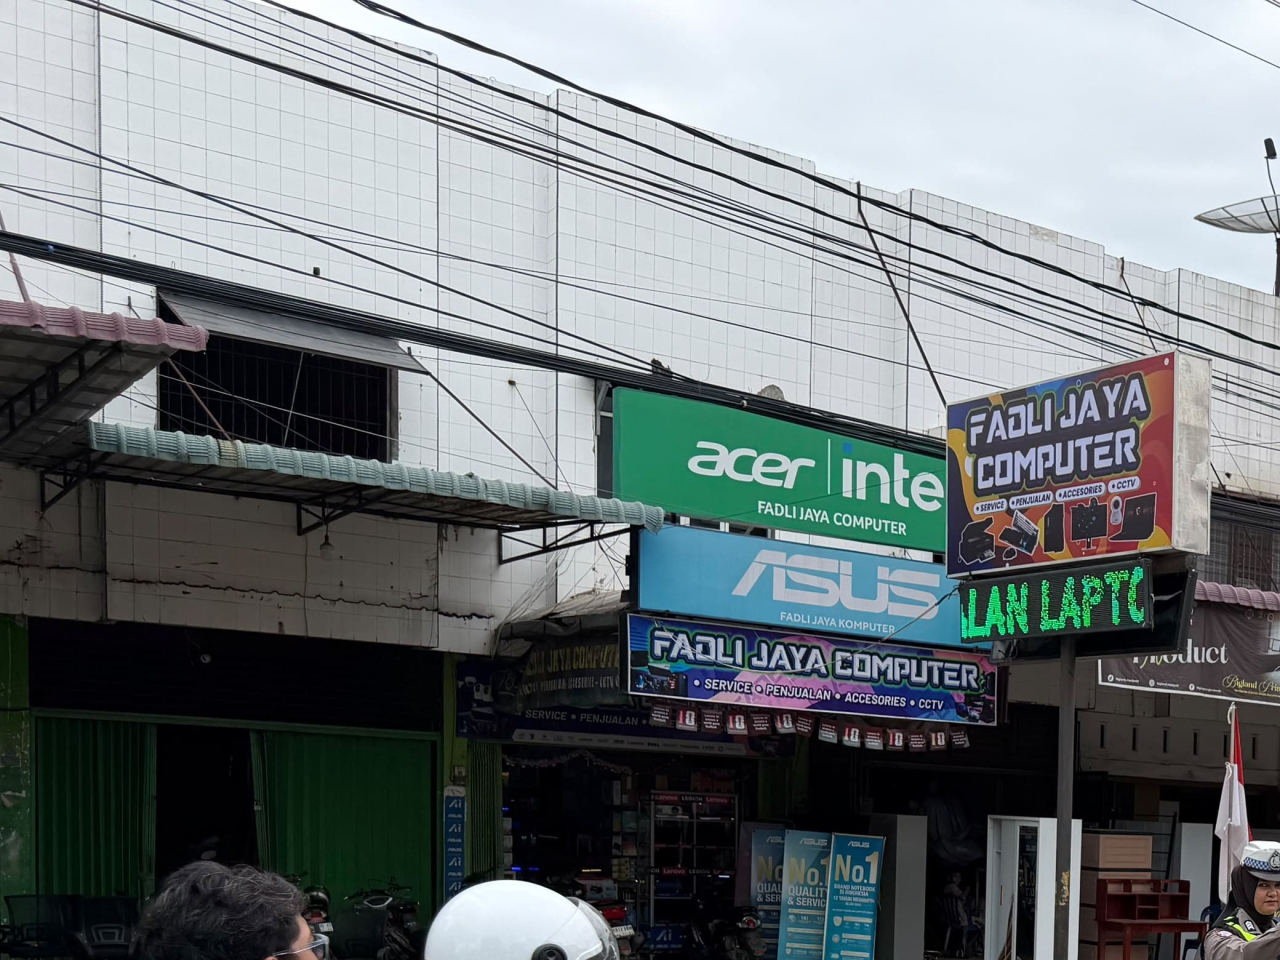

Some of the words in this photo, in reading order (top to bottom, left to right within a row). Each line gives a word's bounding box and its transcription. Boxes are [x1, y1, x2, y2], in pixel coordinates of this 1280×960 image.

[970, 398, 1052, 446] FADLI
[1060, 378, 1147, 429] JAYA
[688, 441, 816, 489] acer
[977, 427, 1137, 490] COMPUTER
[1062, 484, 1103, 499] ACCESORIES
[1116, 478, 1137, 490] CCTV
[980, 501, 1005, 512] SERVICE
[1015, 493, 1051, 506] PENJUALAN
[758, 500, 796, 519] FADLI
[799, 507, 830, 524] JAYA
[833, 512, 907, 535] COMPUTER
[731, 549, 940, 620] ASUS
[780, 611, 811, 625] FADLI
[811, 614, 837, 628] JAYA
[838, 616, 895, 634] KOMPUTER
[653, 630, 743, 666] FADLI
[751, 642, 827, 675] JAYA
[834, 651, 979, 689] COMPUTER
[704, 678, 751, 694] SERVICE
[765, 684, 831, 701] PENJUALAN
[844, 692, 906, 708] ACCESORIES
[918, 698, 944, 710] CCTV
[525, 709, 568, 721] SERVICE
[580, 713, 638, 725] PENJUALAN
[799, 837, 828, 846] ASUS
[847, 840, 870, 848] ASUS
[834, 851, 880, 885] No.1
[787, 897, 795, 906] &
